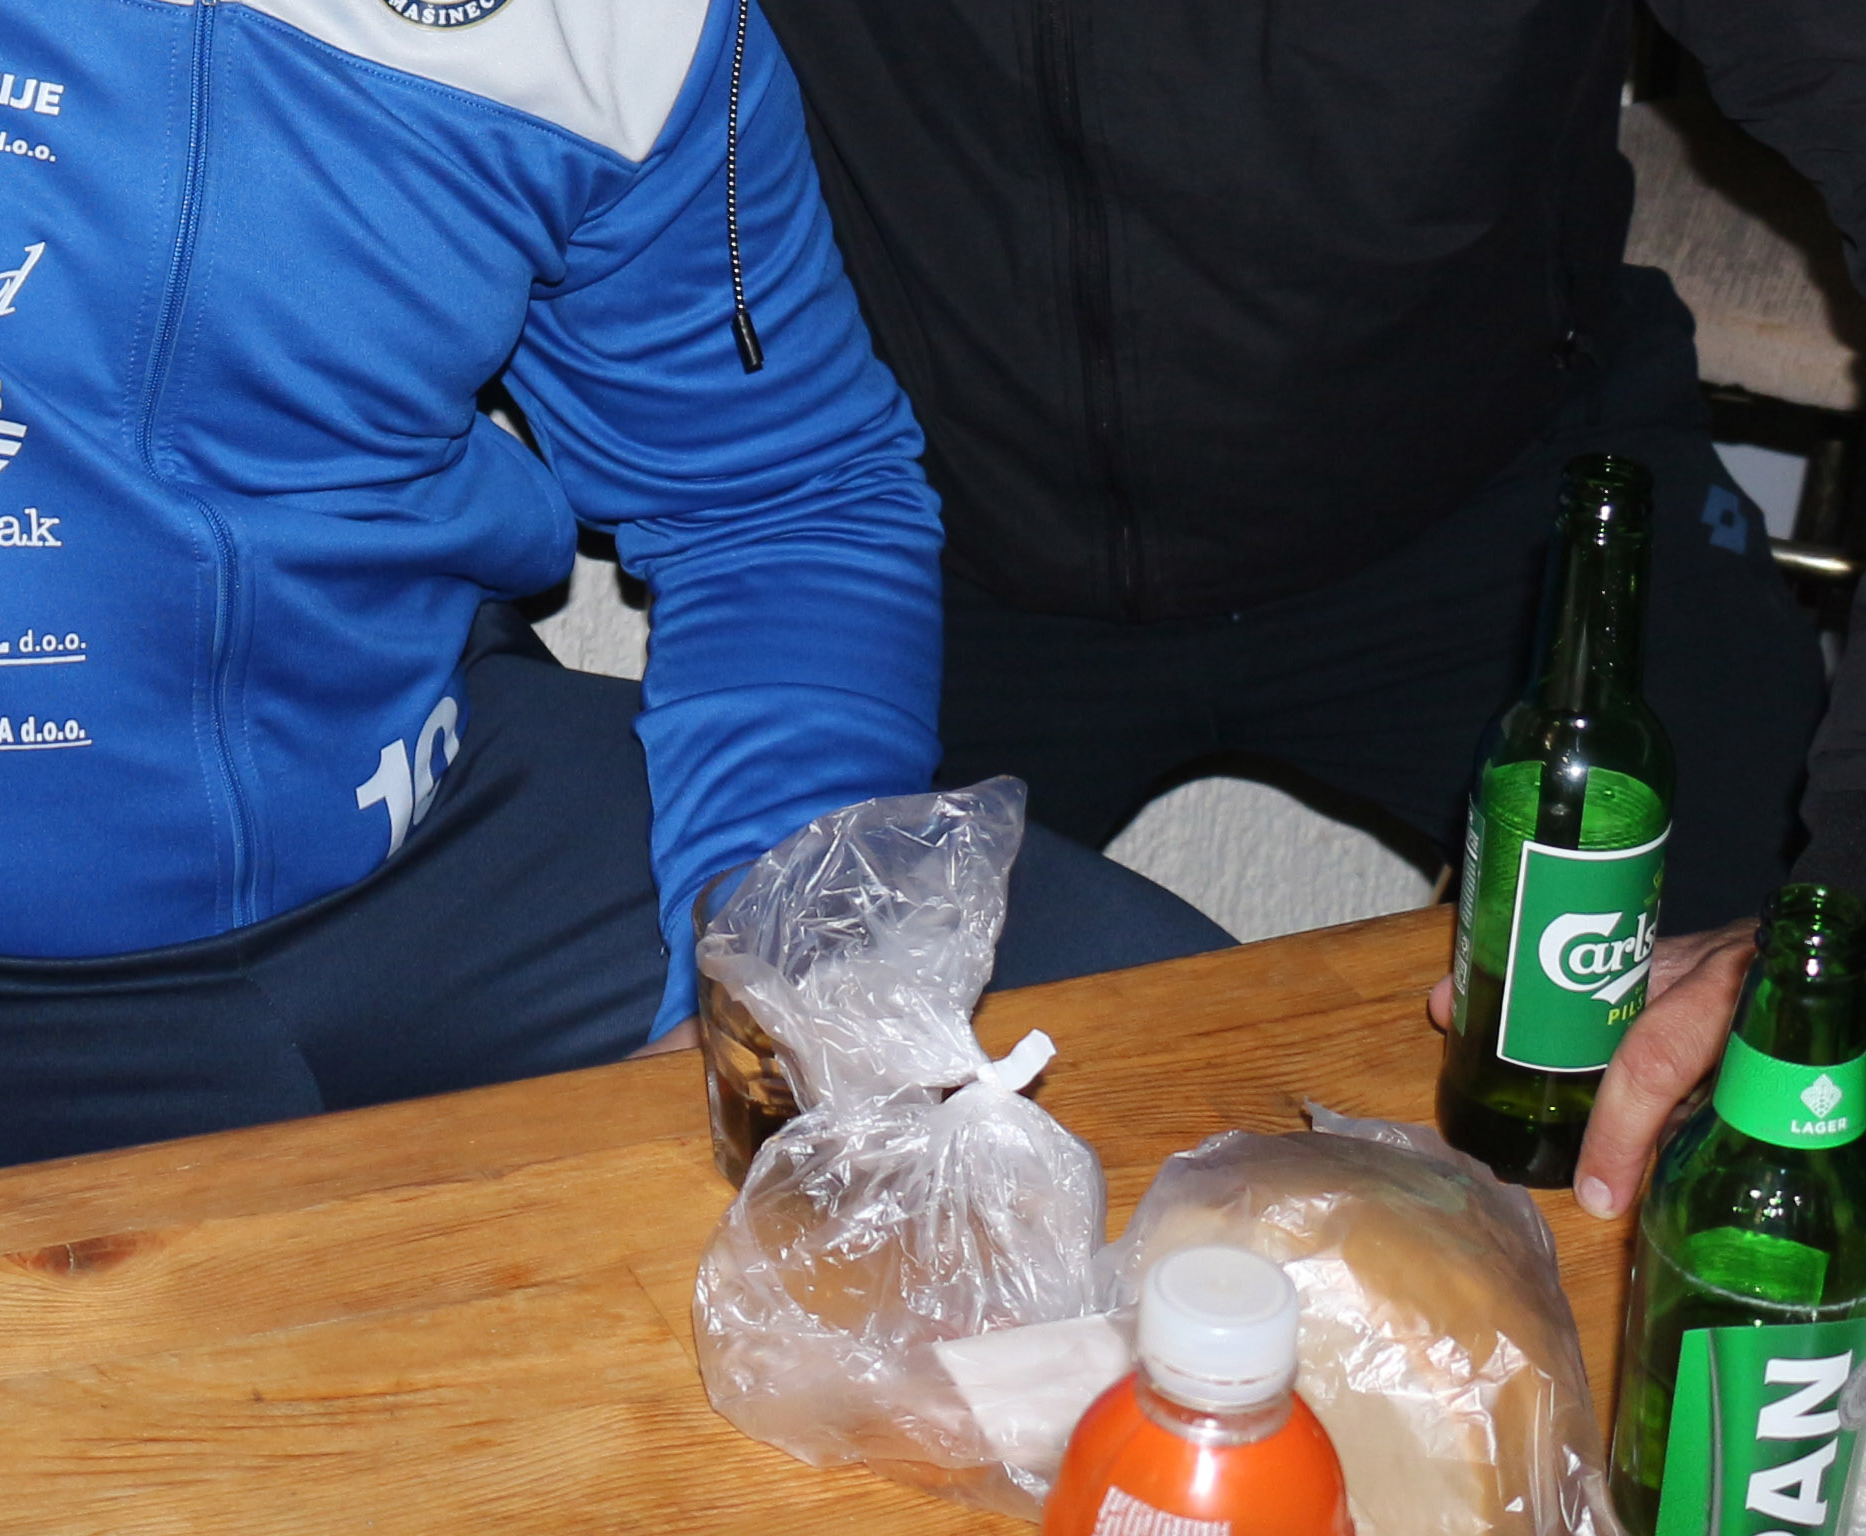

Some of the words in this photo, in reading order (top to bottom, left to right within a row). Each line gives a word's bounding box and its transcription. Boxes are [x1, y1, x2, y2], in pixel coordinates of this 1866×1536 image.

[18, 629, 86, 653] d.o.o.
[20, 716, 86, 742] d.o.o.
[356, 696, 460, 859] 10
[1538, 911, 1657, 993] Carls
[1790, 1117, 1848, 1135] LAGER
[1745, 1348, 1853, 1536] AN
